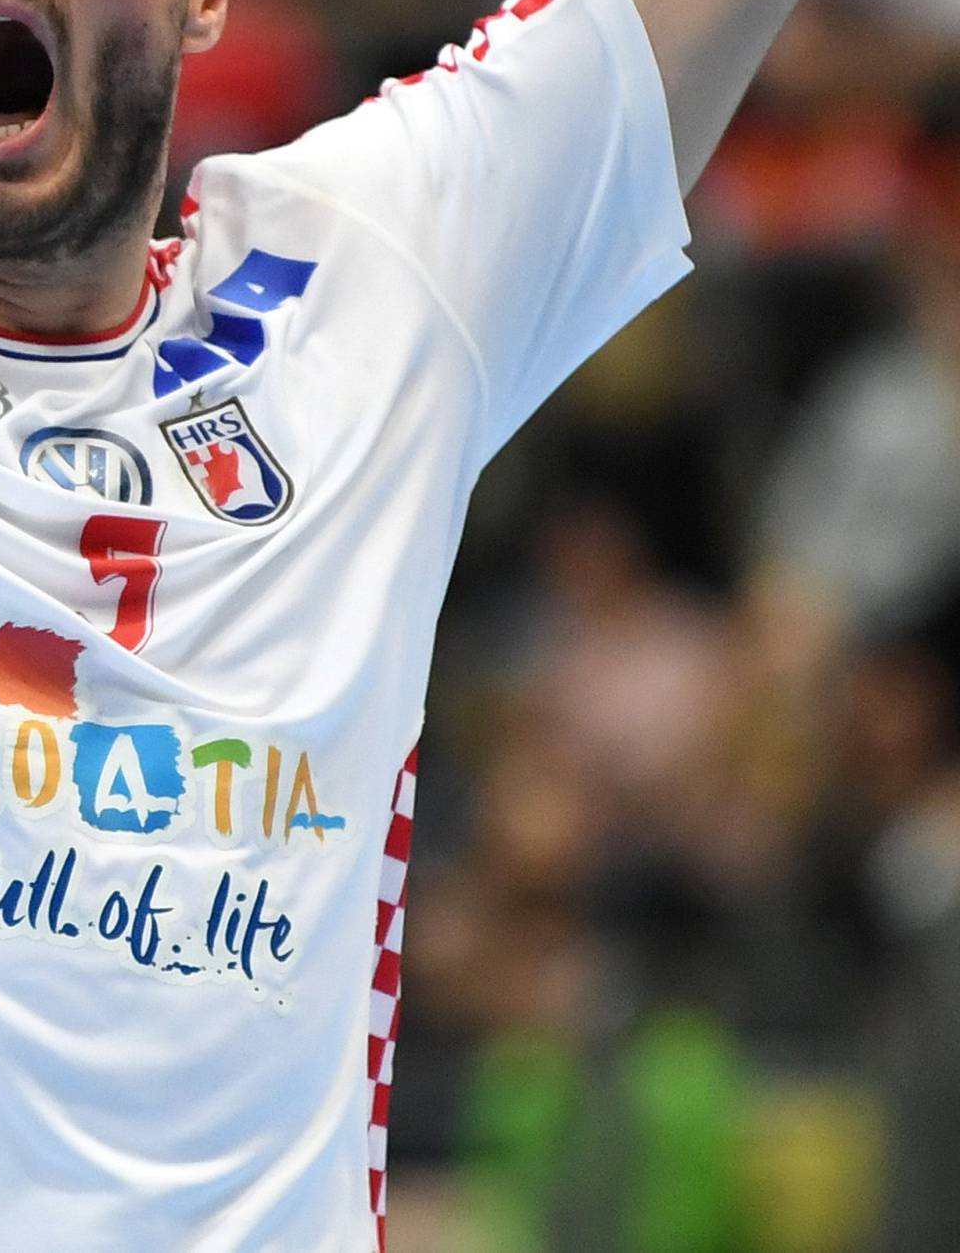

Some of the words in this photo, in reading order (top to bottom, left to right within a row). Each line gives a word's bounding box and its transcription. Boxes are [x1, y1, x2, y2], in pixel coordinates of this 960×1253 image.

[171, 411, 242, 450] HRS
[99, 865, 173, 966] of
[206, 872, 294, 979] life
